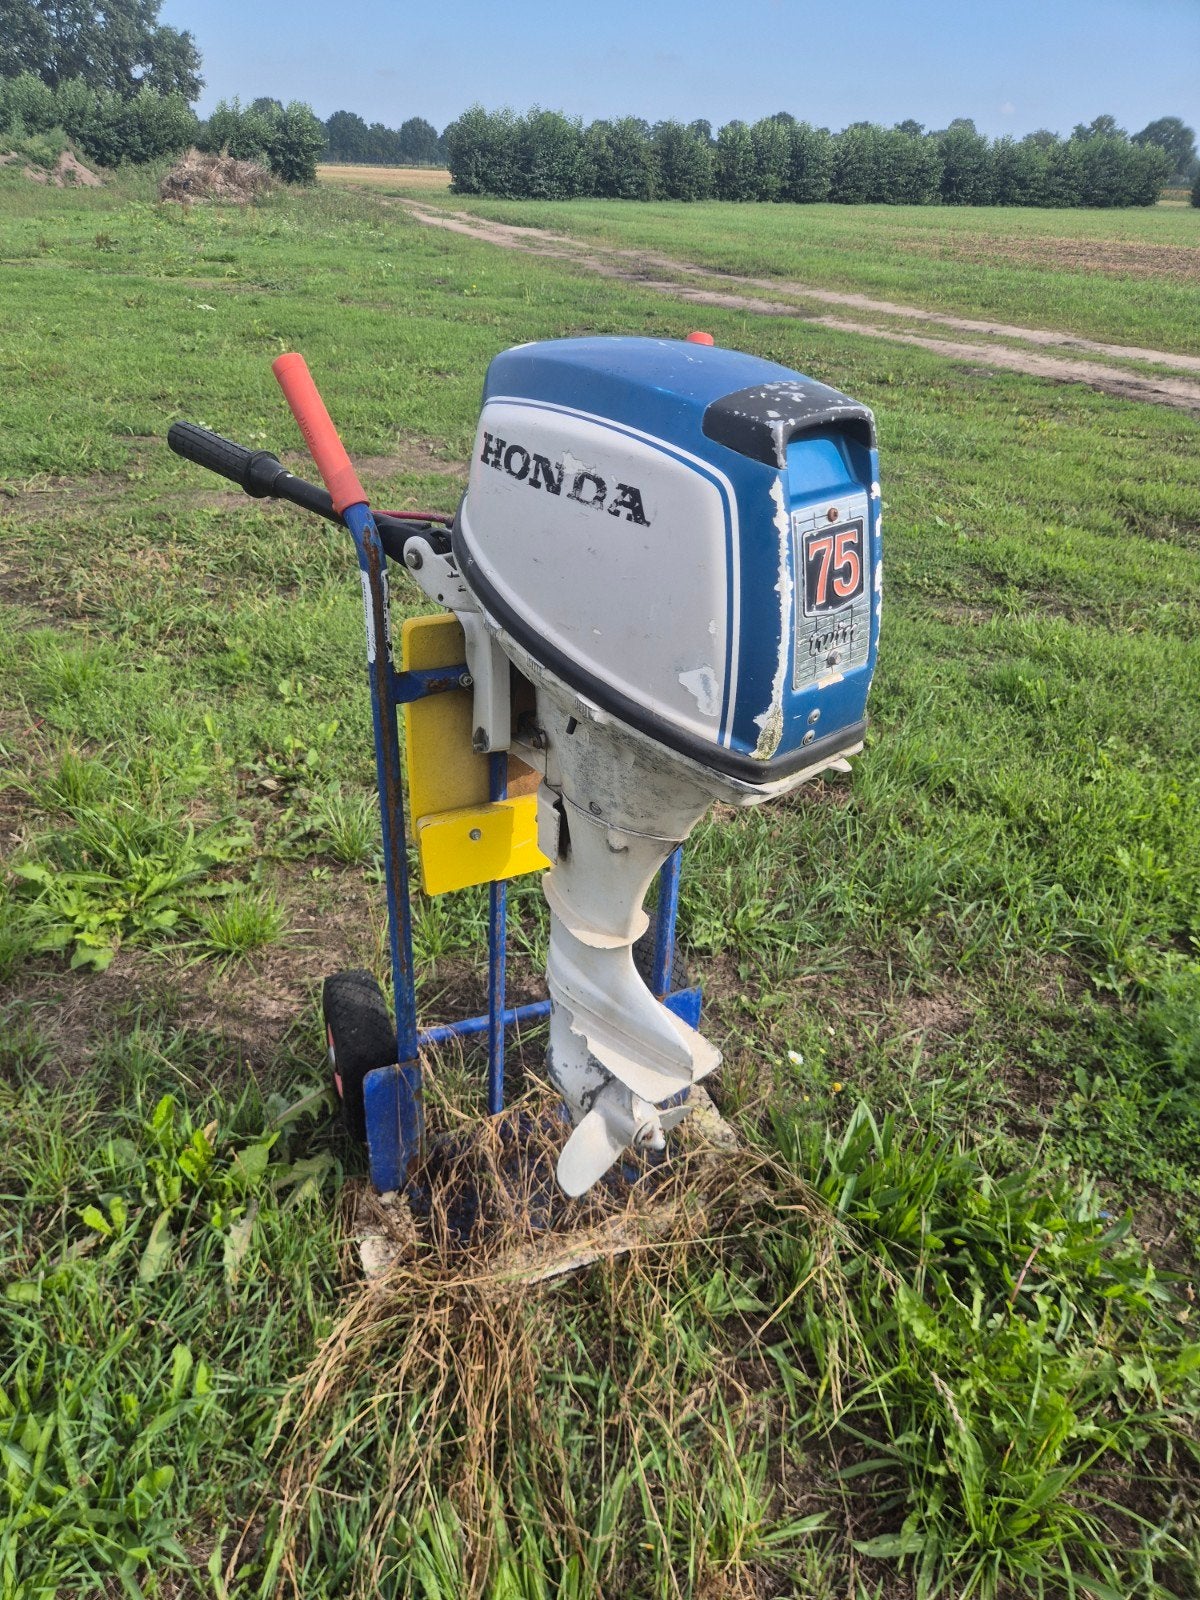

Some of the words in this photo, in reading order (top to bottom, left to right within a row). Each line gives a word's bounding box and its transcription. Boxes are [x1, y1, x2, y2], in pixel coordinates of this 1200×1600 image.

[481, 432, 651, 527] HONDA
[808, 529, 860, 605] 75
[809, 622, 858, 657] twin
